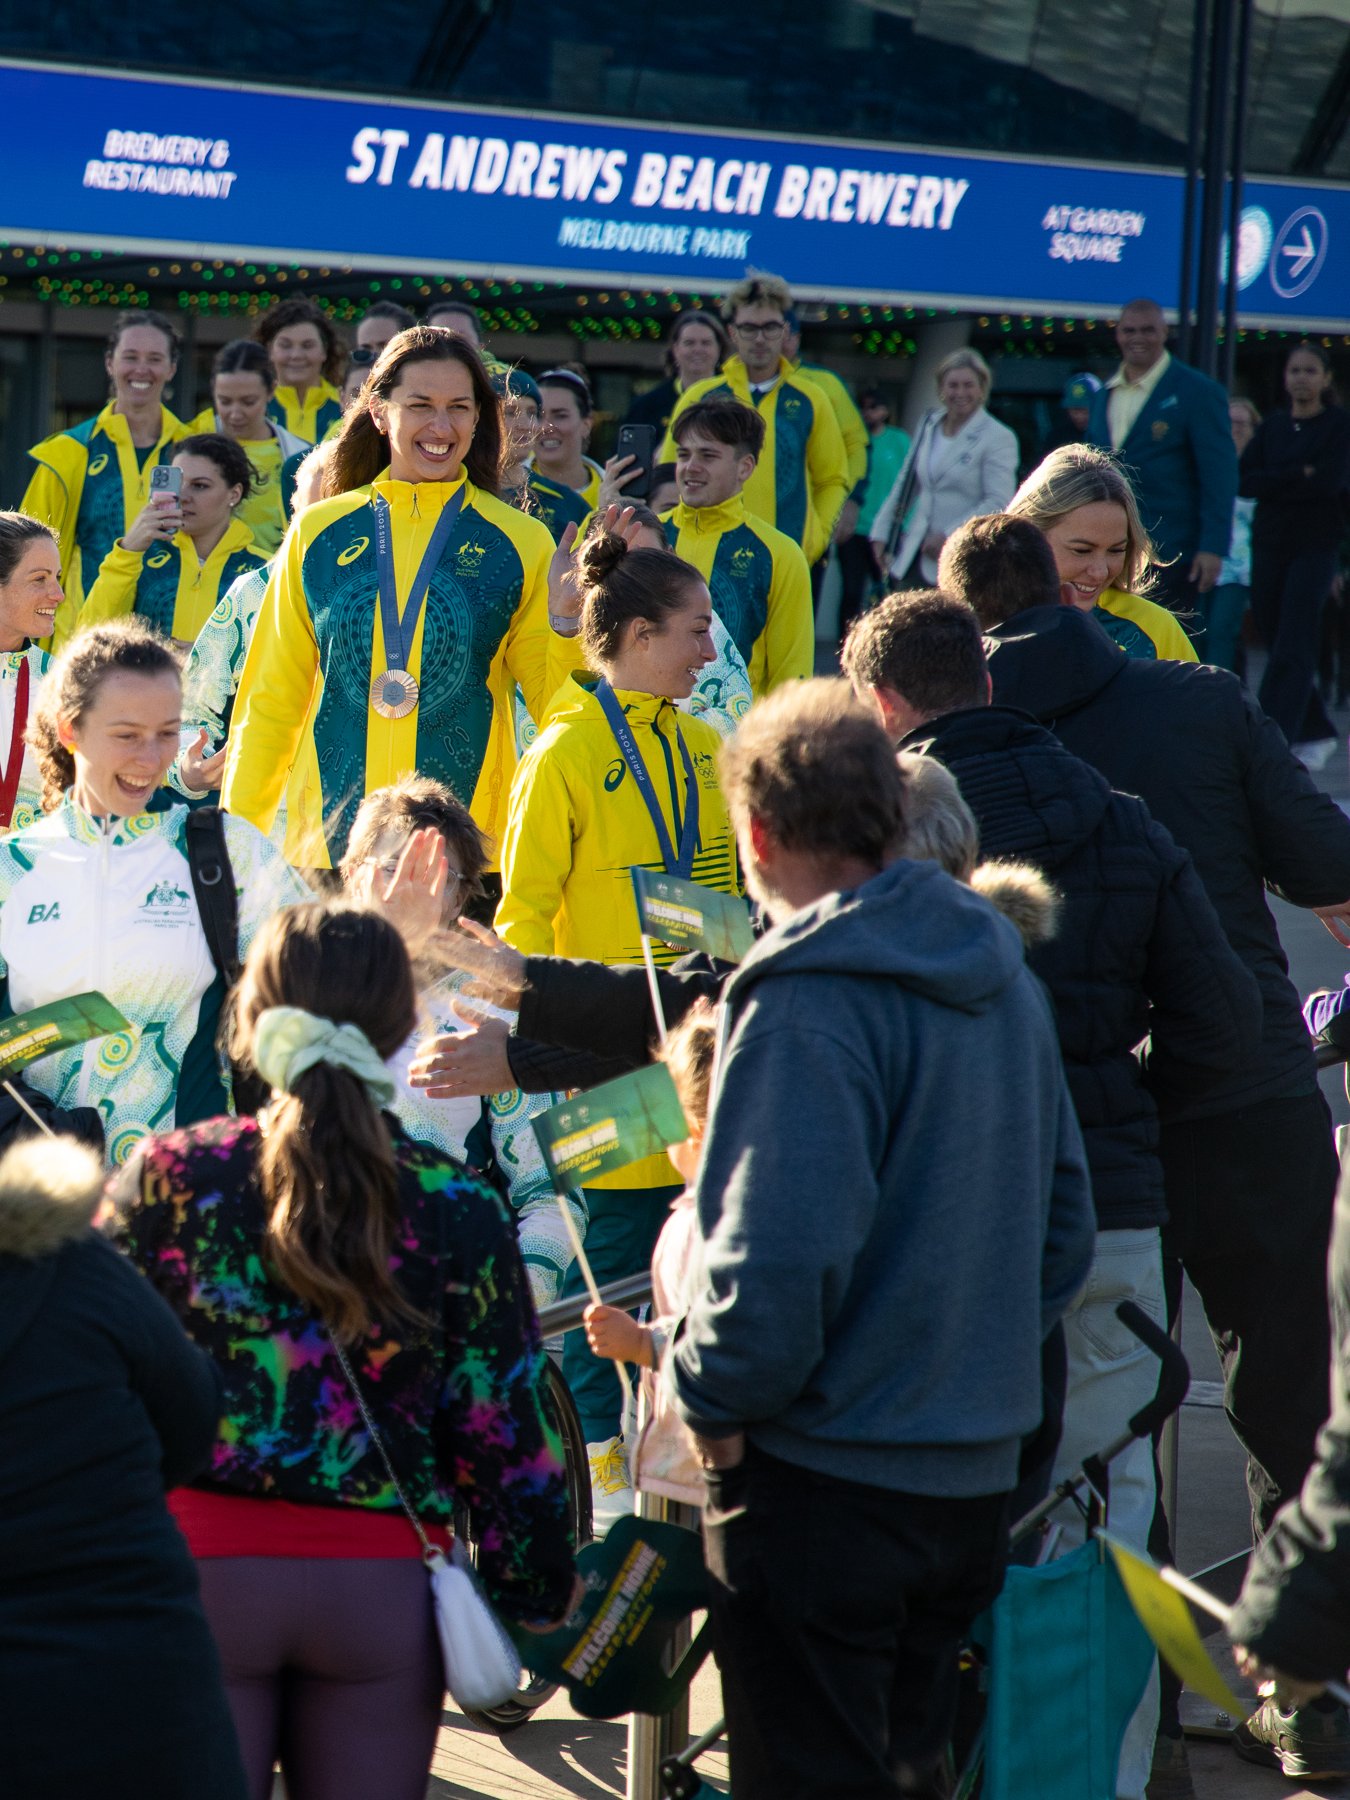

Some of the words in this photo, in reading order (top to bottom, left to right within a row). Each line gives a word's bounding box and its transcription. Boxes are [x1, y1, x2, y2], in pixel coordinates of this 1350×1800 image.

[103, 129, 213, 166] BREWERY
[209, 139, 230, 168] &
[83, 159, 237, 200] RESTAURANT
[346, 127, 409, 186] ST
[408, 132, 627, 204] ANDREWS
[631, 152, 772, 216] BEACH
[773, 164, 970, 230] BREWERY
[1041, 204, 1072, 231] AT
[1069, 206, 1147, 237] GARDEN
[557, 216, 691, 255] MELBOURNE
[690, 226, 752, 260] PARK
[1047, 231, 1126, 264] SQUARE
[378, 507, 386, 530] 2024
[379, 530, 387, 554] PARIS
[618, 728, 633, 753] 2024
[629, 754, 645, 781] PARIS
[569, 1594, 630, 1681] WELCOME
[620, 1543, 658, 1600] HOME
